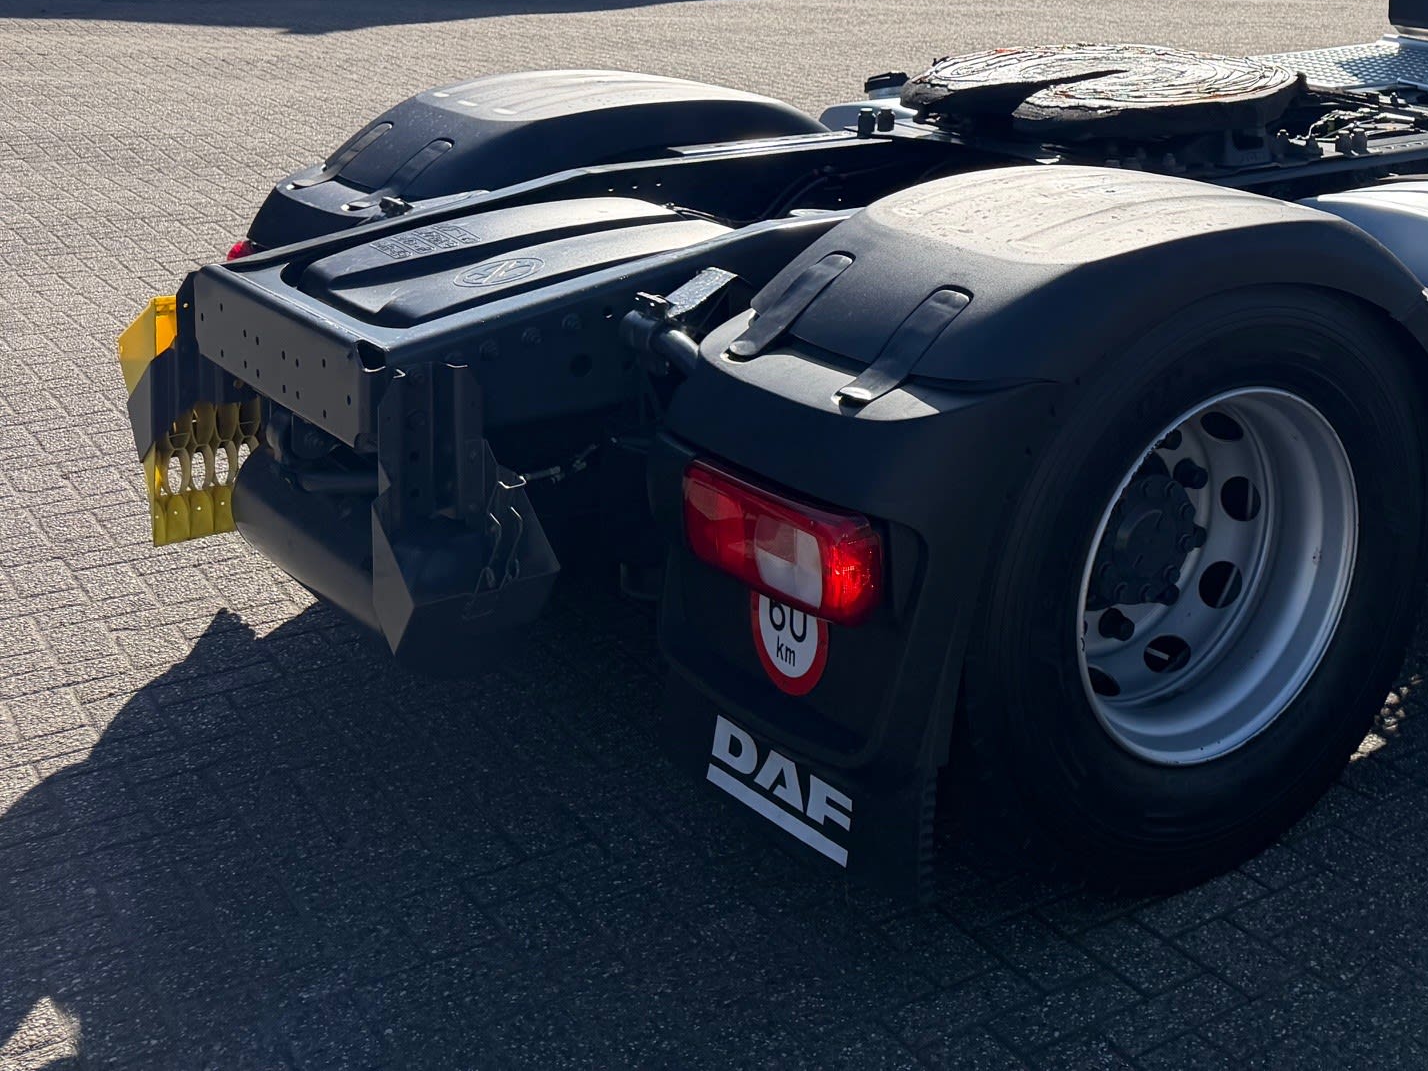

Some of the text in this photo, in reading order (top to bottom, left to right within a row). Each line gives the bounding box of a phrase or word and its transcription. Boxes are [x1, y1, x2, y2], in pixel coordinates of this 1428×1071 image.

[768, 596, 808, 644] 60
[776, 635, 796, 668] km
[711, 714, 853, 832] DAF
